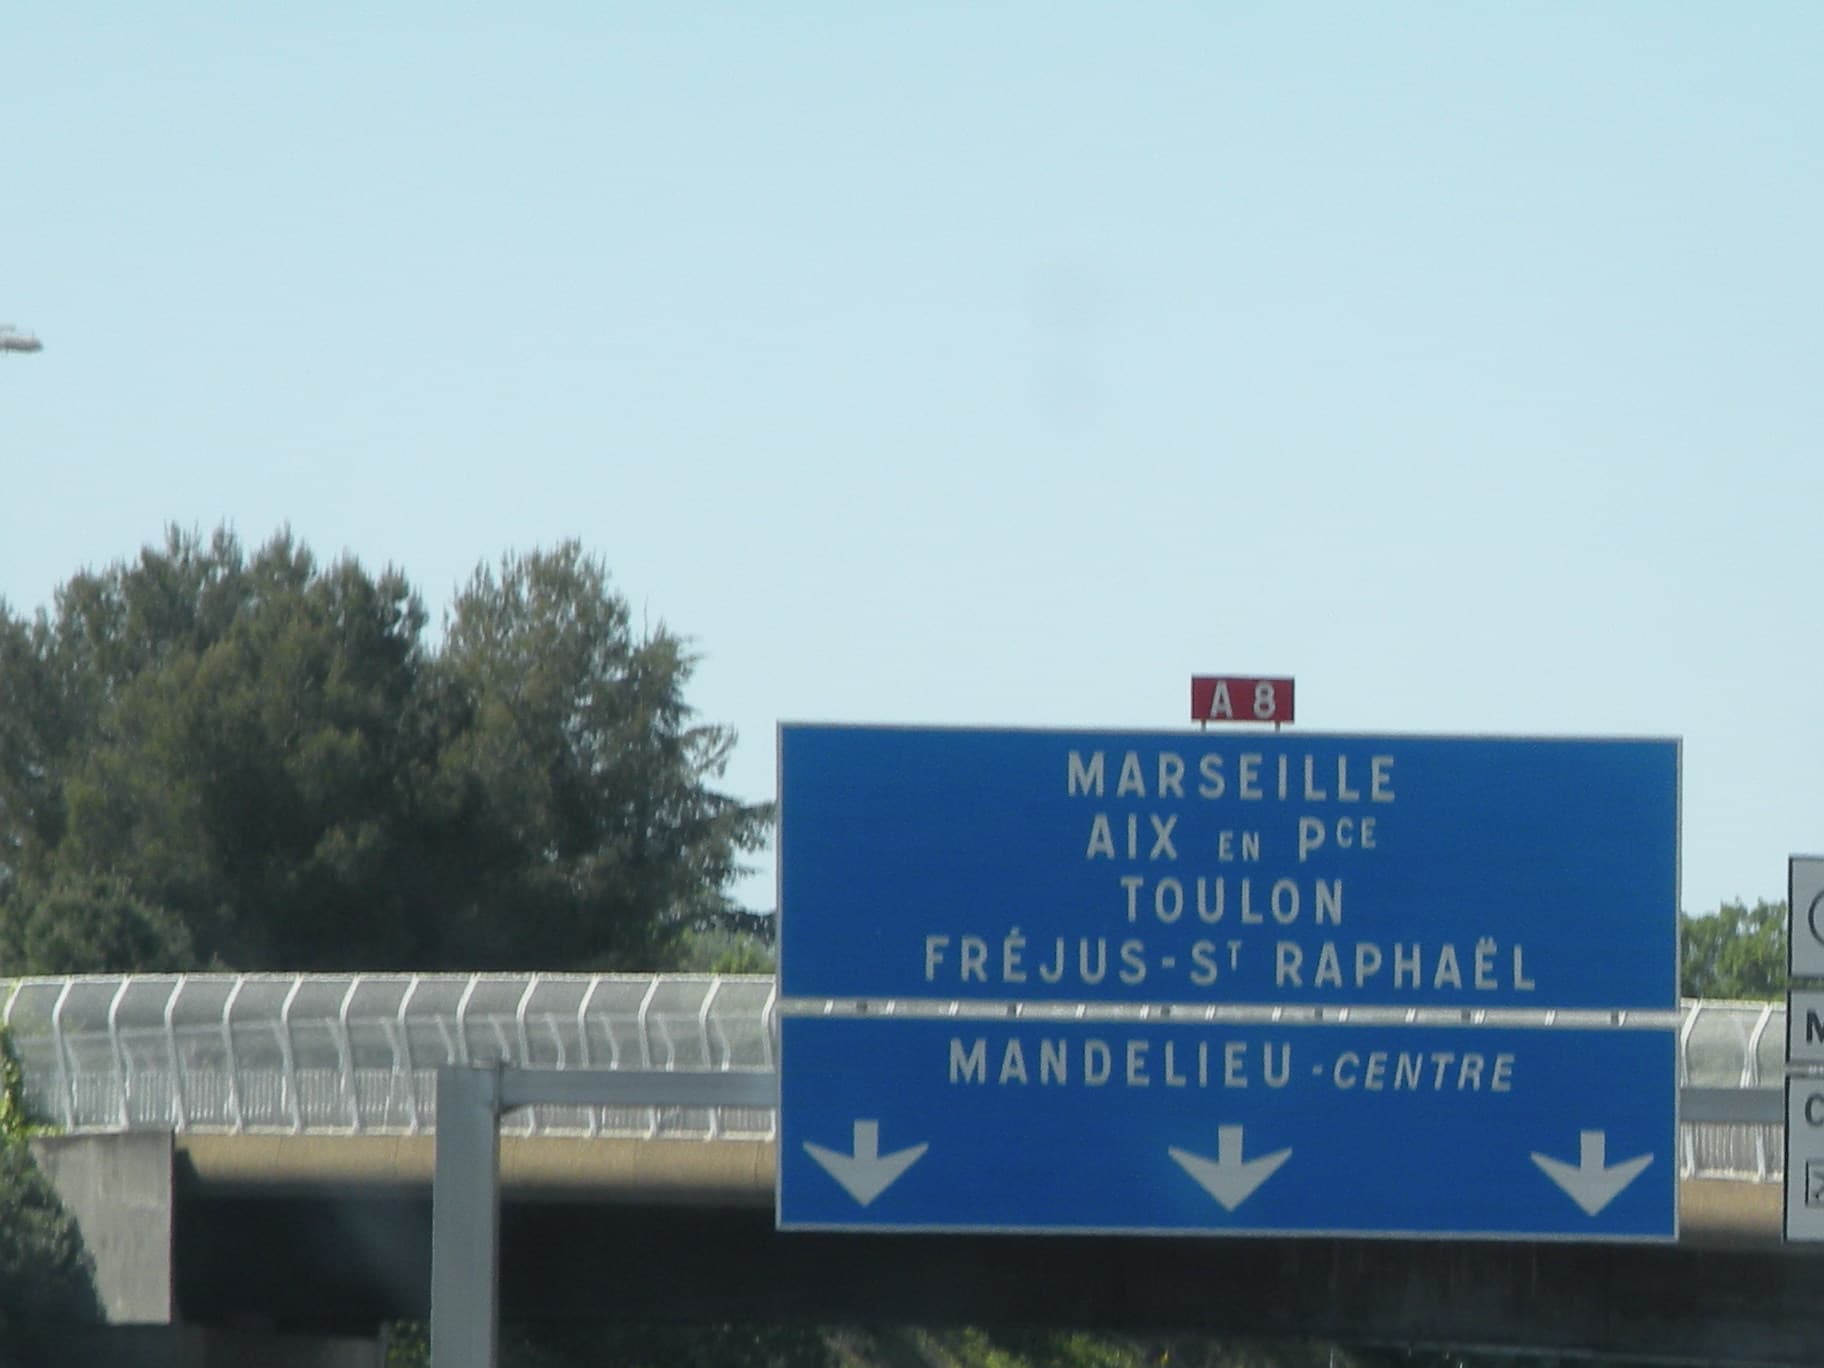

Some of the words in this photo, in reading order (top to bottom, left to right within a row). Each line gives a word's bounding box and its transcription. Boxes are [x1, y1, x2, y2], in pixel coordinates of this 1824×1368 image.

[1209, 682, 1233, 719] A
[1252, 682, 1277, 719] 8
[1067, 750, 1396, 803] MARSEILLE
[1085, 813, 1178, 861] AIX
[1217, 830, 1261, 862] EN
[1119, 875, 1344, 926] TOULON
[1275, 936, 1537, 991] RAPHAËL
